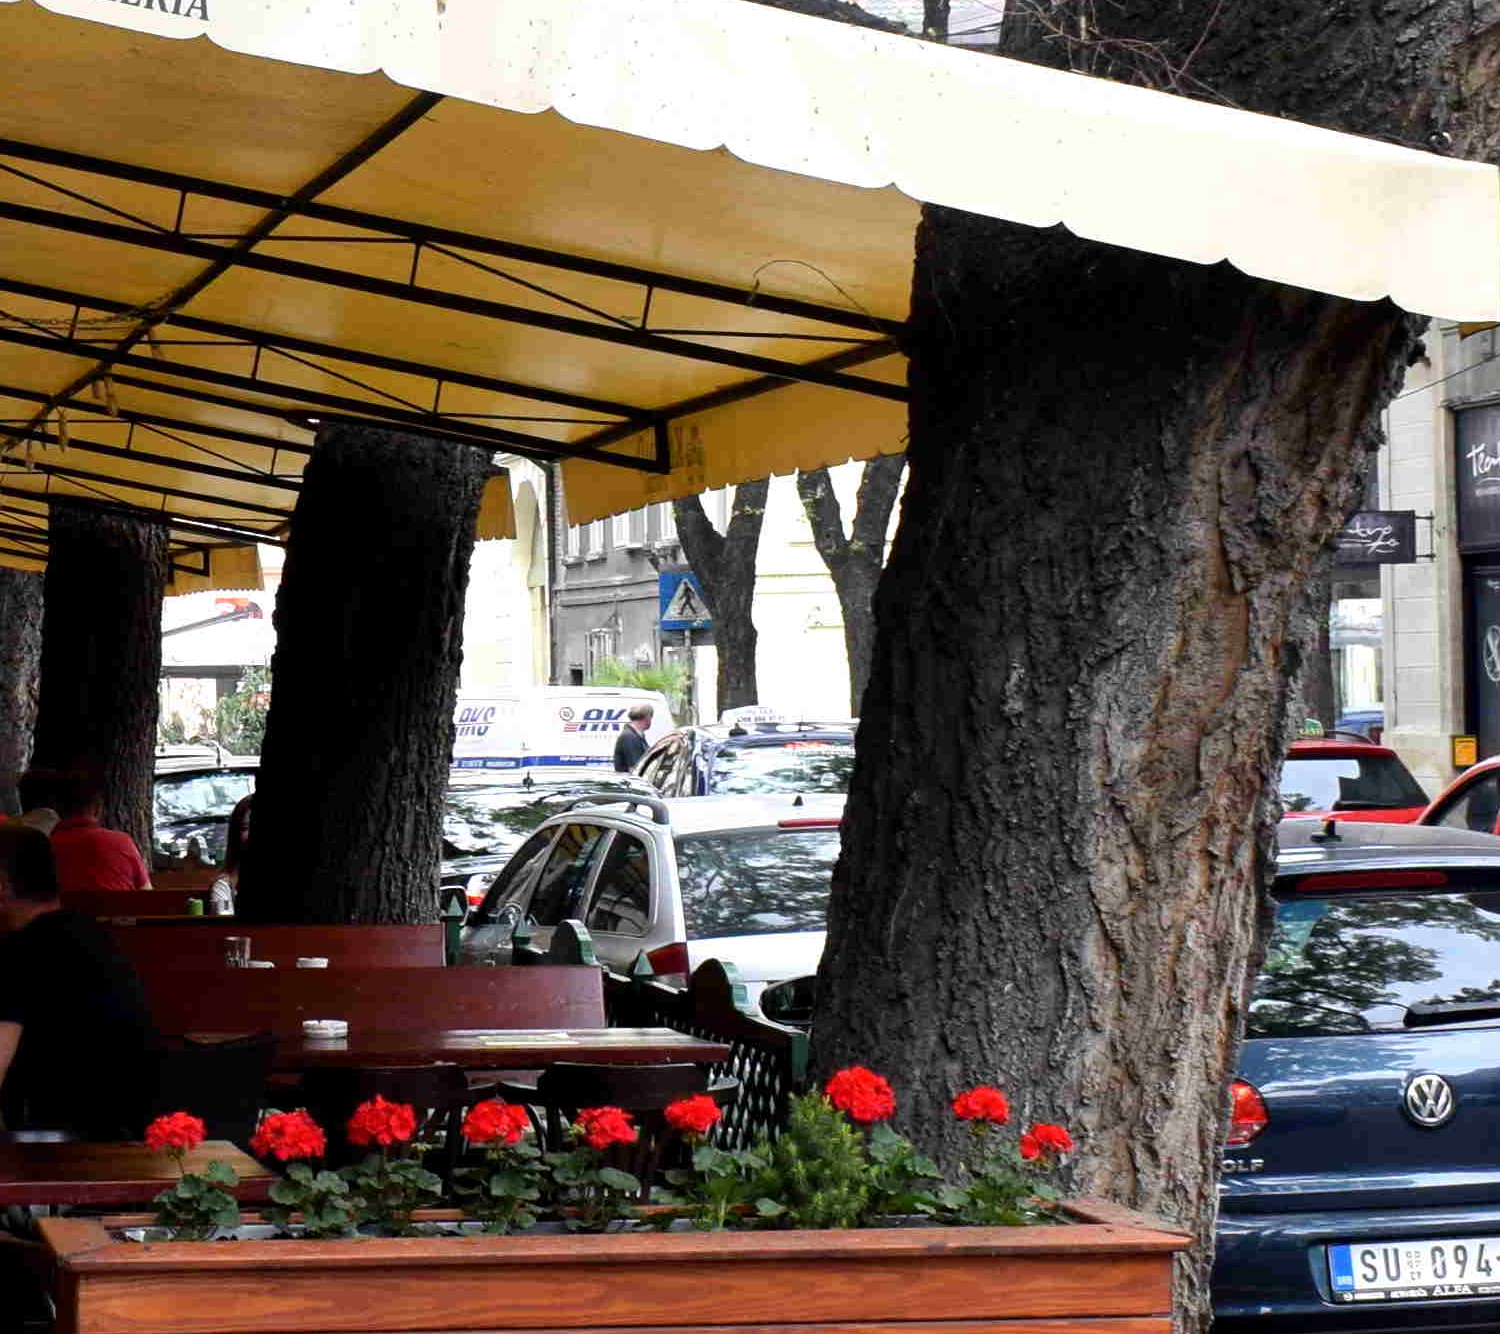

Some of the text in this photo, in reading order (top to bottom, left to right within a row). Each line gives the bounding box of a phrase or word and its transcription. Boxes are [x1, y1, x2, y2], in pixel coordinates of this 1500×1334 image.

[578, 708, 629, 732] AK
[1222, 1158, 1265, 1173] OLF
[1360, 1246, 1401, 1283] SU
